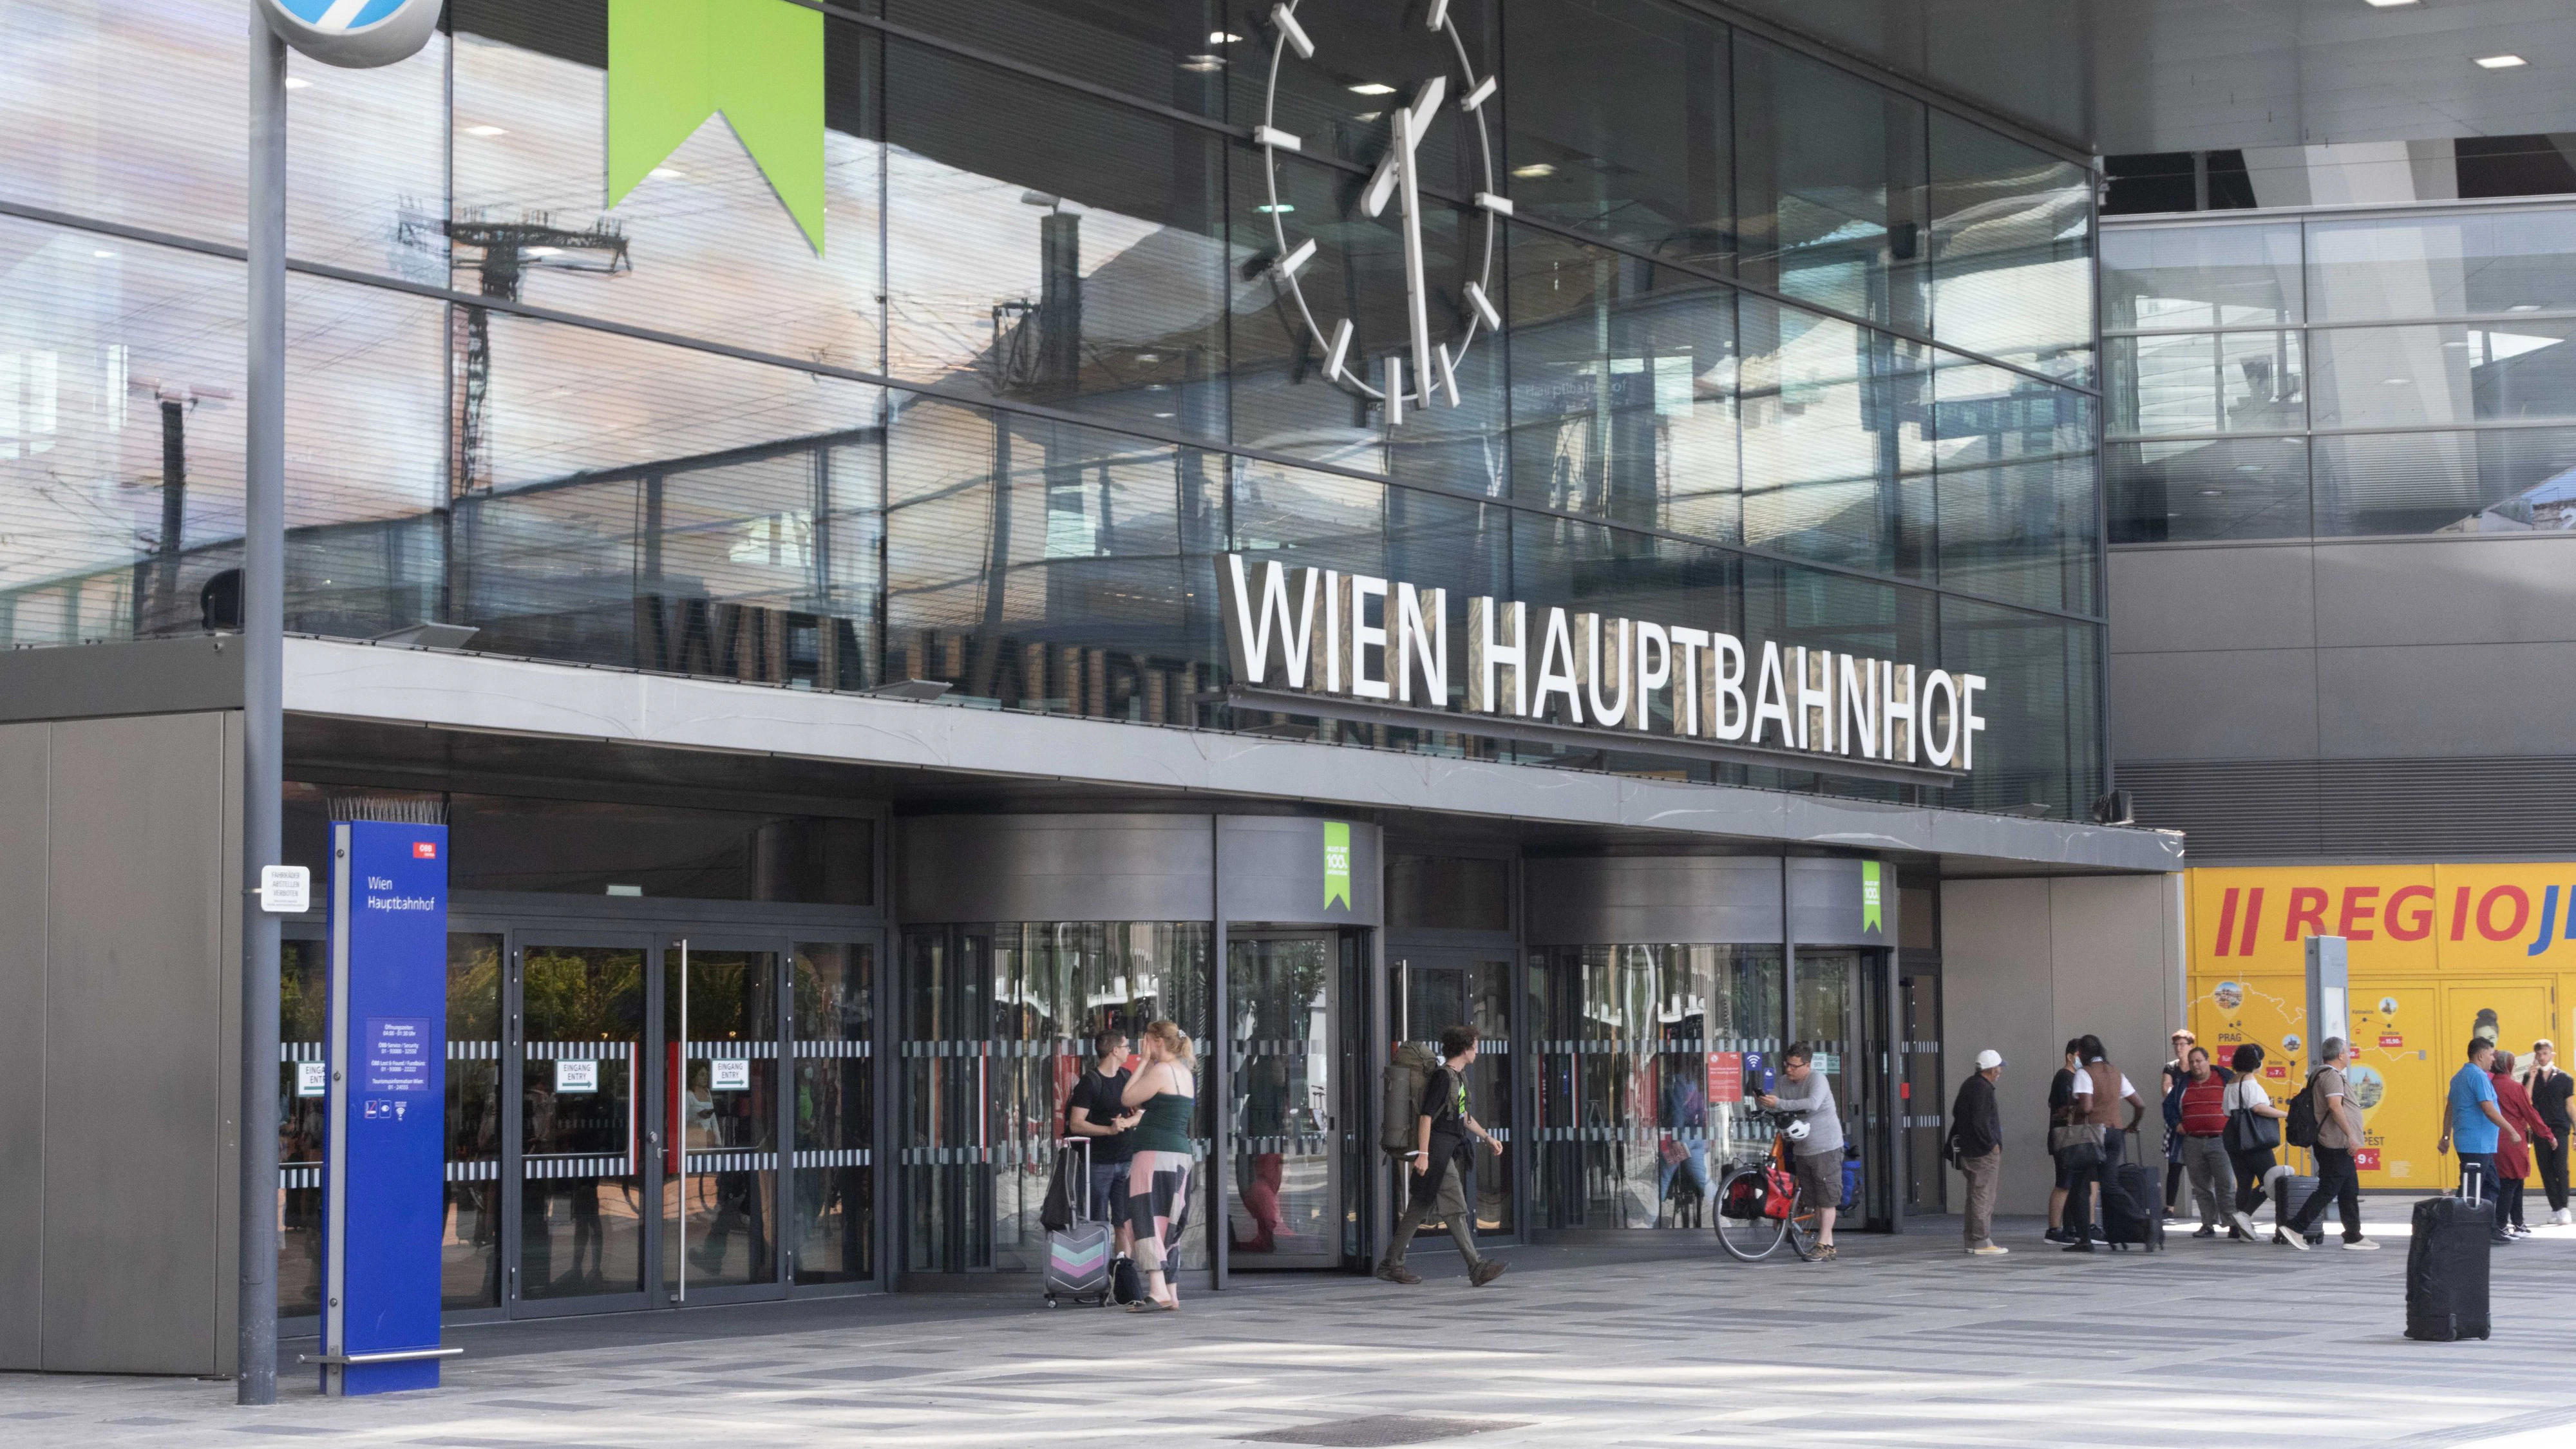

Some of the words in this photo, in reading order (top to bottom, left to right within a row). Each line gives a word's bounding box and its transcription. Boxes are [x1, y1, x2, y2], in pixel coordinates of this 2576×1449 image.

[1226, 553, 1447, 707] WIEN
[1481, 595, 1987, 772] HAUPTBAHNHOF
[368, 876, 393, 890] Wien
[368, 895, 435, 912] Hauptbahnhof
[2284, 885, 2576, 956] REGIOJ
[2218, 1033, 2242, 1042] PRAG
[2358, 1153, 2367, 1164] 9
